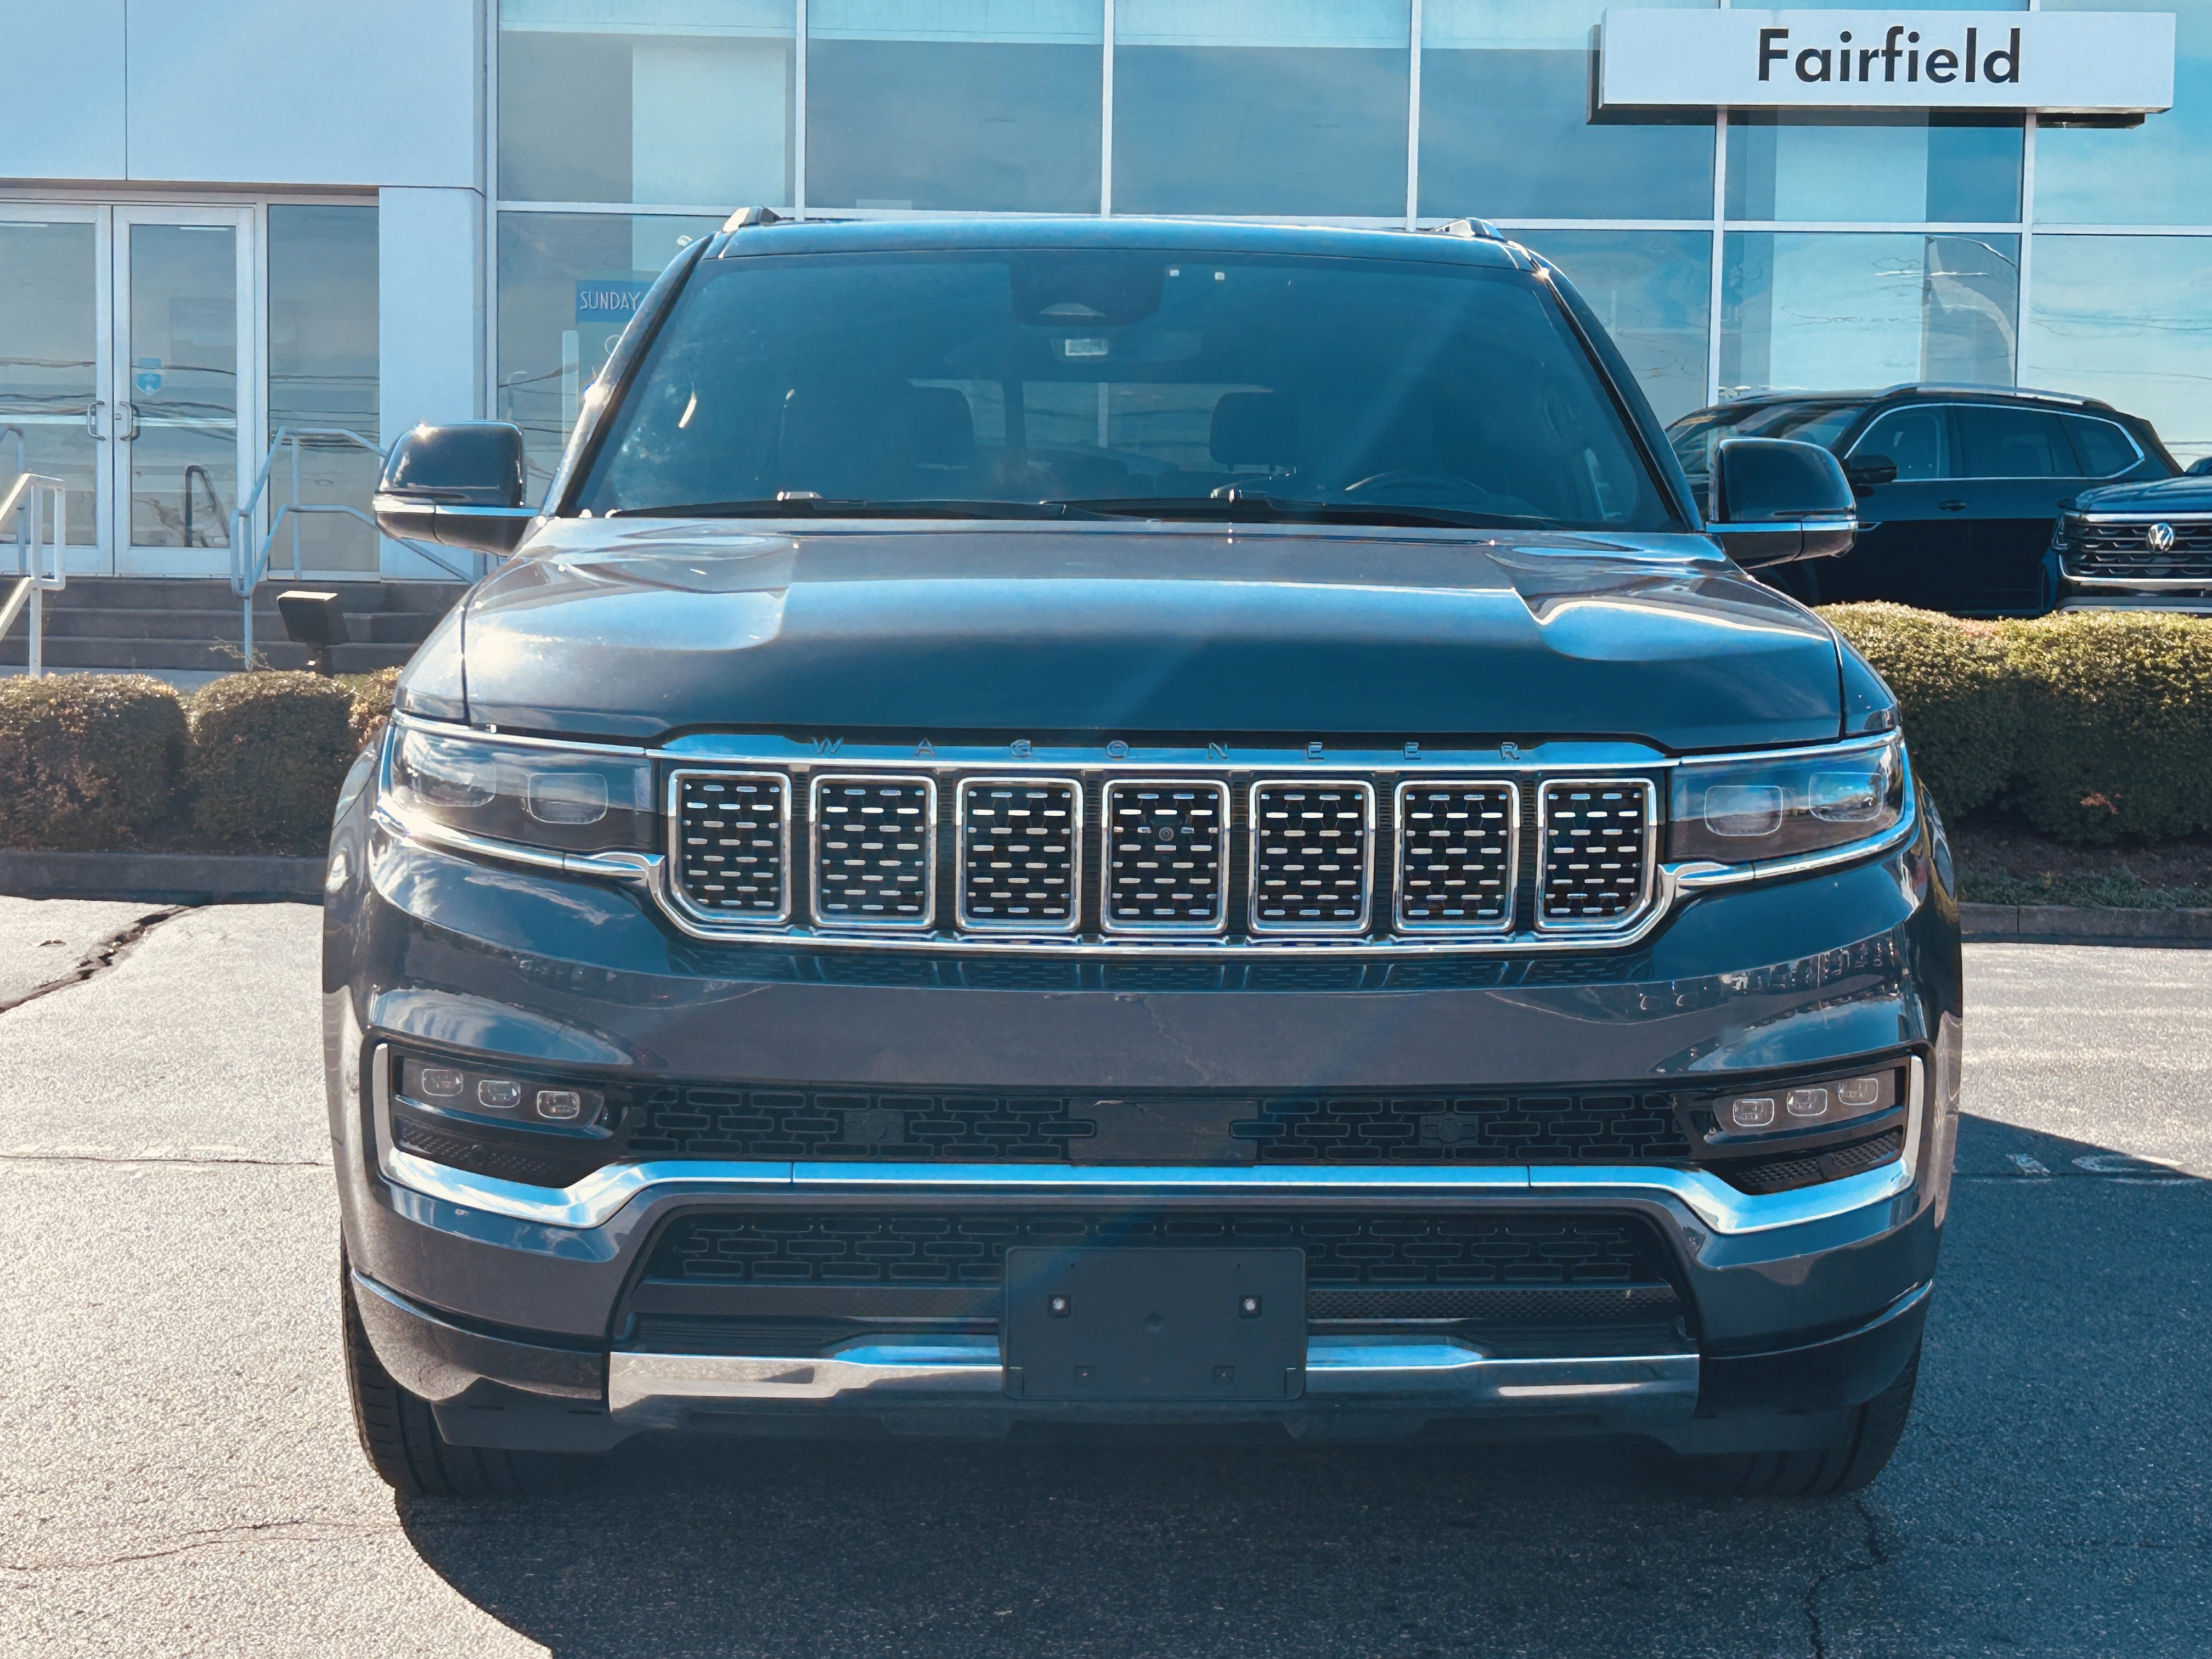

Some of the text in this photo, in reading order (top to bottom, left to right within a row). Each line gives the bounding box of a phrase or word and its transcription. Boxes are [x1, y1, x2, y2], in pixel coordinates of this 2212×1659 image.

[1758, 26, 2021, 83] Fairfield
[580, 291, 641, 310] SUNDAY
[812, 736, 1520, 761] WAGONEER
